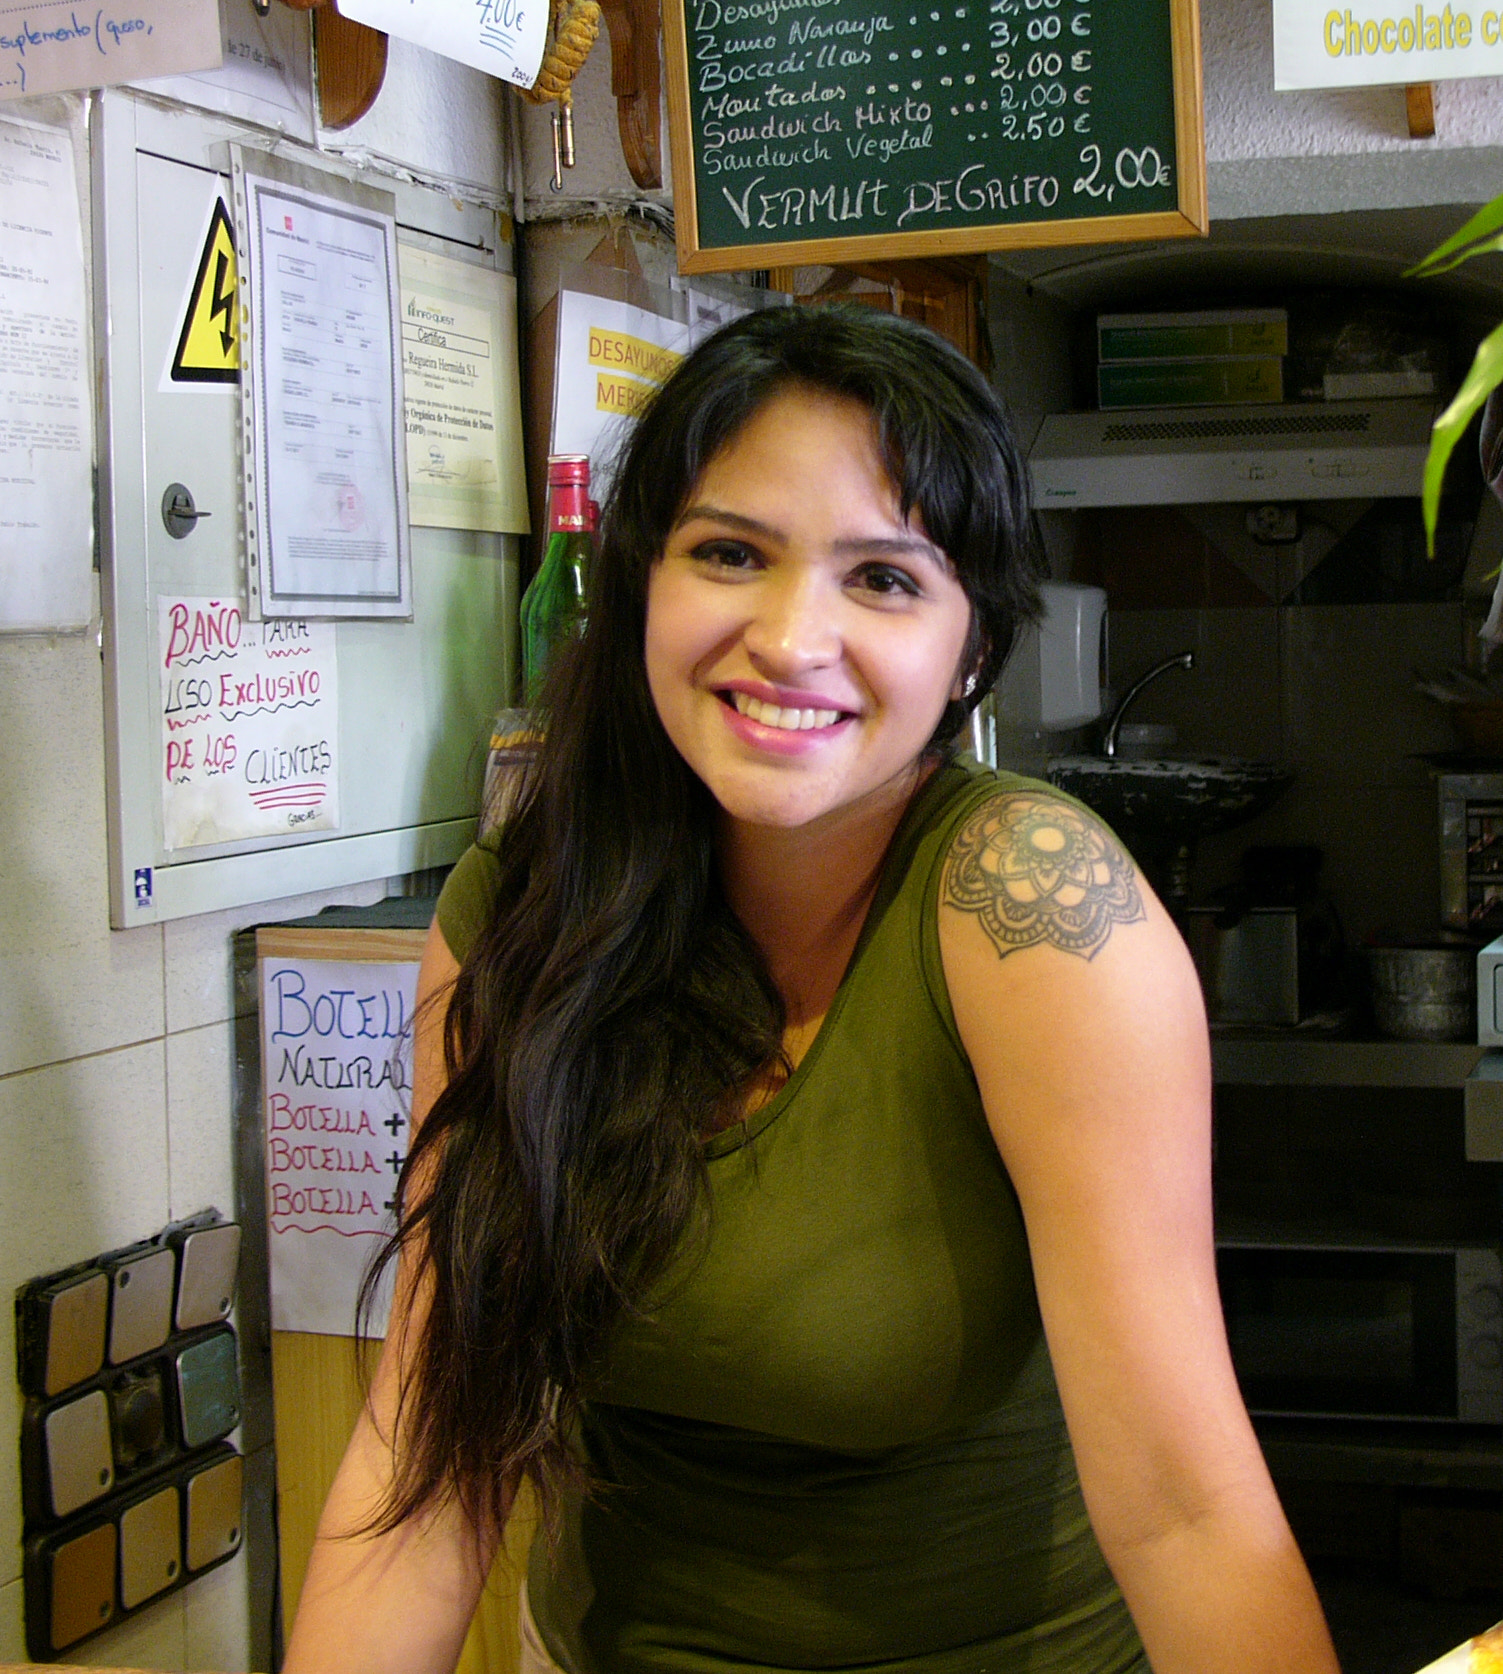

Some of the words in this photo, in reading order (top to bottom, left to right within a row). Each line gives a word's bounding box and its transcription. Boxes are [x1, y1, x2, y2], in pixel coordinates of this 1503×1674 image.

[695, 34, 777, 61] Zumo
[788, 15, 895, 46] Naranja
[988, 15, 1062, 49] 3,00
[1071, 13, 1091, 36] €
[1323, 4, 1472, 58] Chocolate
[1481, 10, 1503, 46] c
[699, 44, 872, 94] Bocadillos
[990, 51, 1063, 82] 2,00
[1071, 50, 1092, 72] €
[701, 81, 847, 121] Montados
[1000, 82, 1068, 112] 2,00
[1074, 85, 1092, 105] €
[703, 111, 843, 150] Sandwich
[855, 96, 932, 130] Mixto
[1074, 112, 1091, 133] €
[703, 138, 832, 176] Sandwich
[846, 123, 934, 164] Vegetal
[202, 734, 237, 774] LOS
[245, 740, 332, 784] CLIENTES
[278, 1045, 412, 1090] NATURAL
[269, 1093, 376, 1136] BOTELLA
[270, 1138, 381, 1174] BOTELLA
[271, 1182, 378, 1216] BOTELLA
